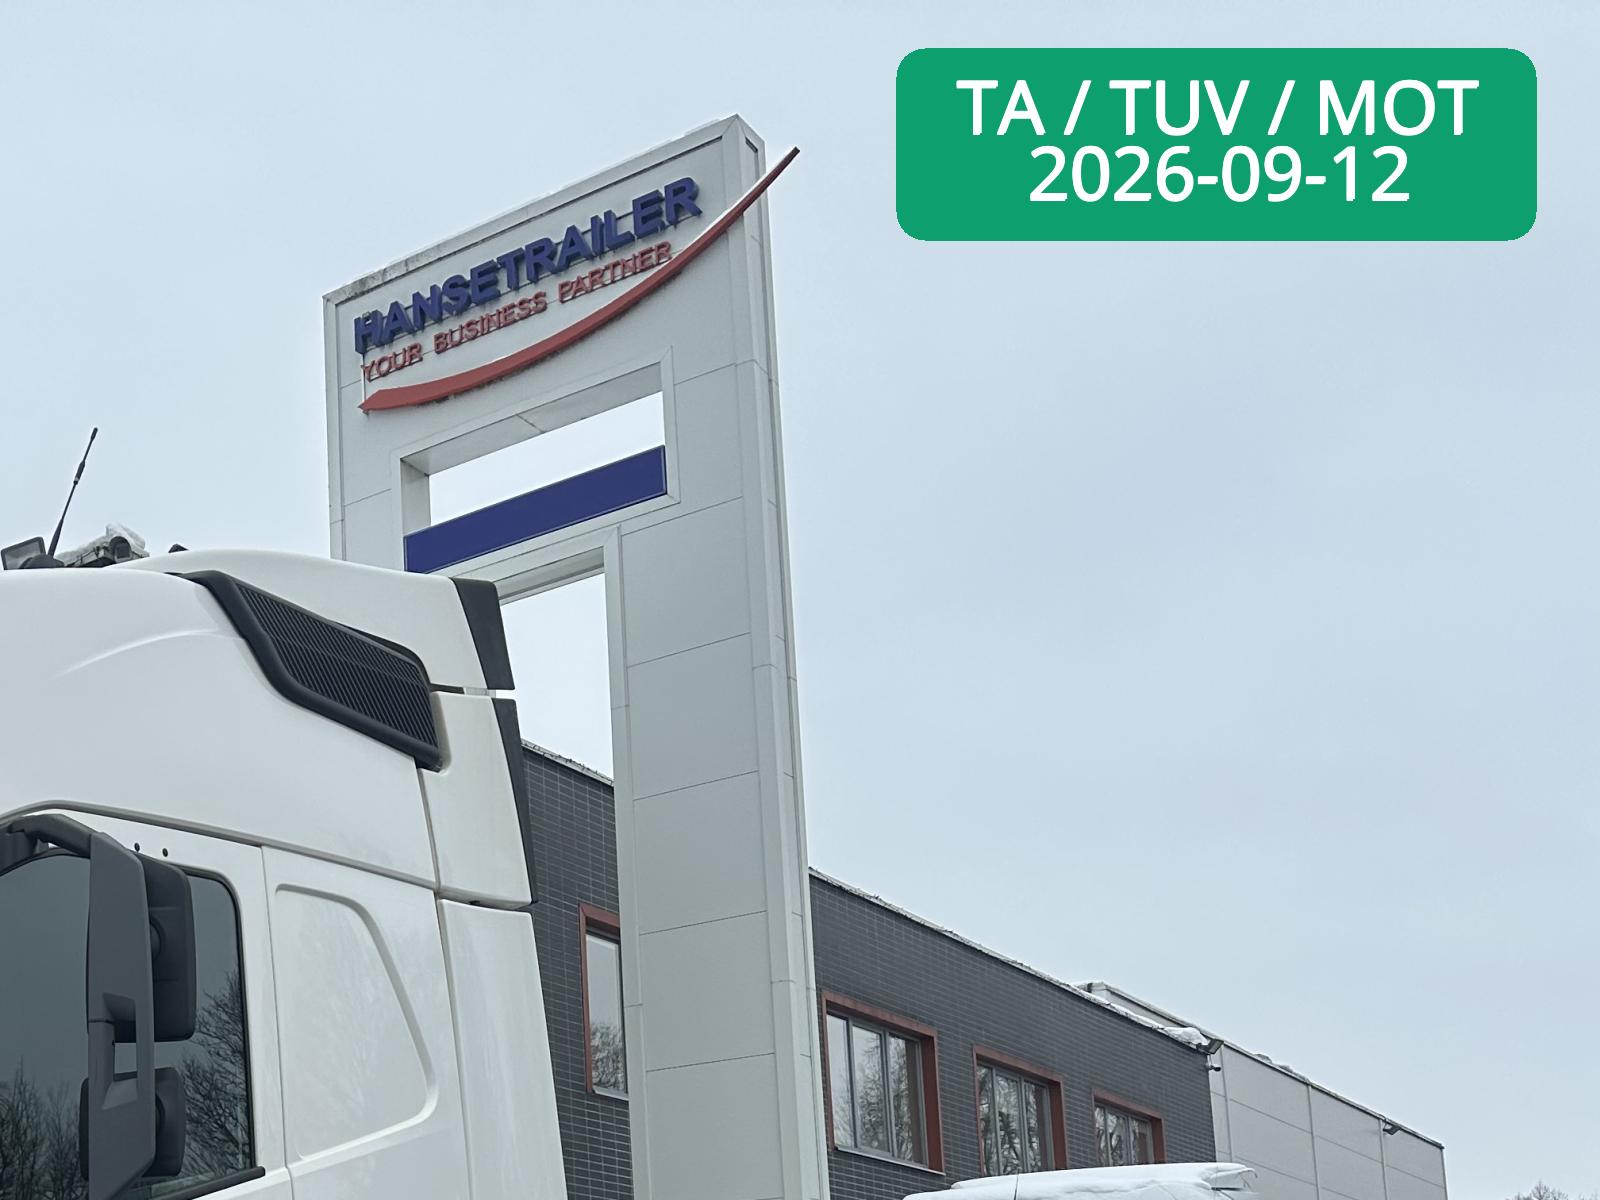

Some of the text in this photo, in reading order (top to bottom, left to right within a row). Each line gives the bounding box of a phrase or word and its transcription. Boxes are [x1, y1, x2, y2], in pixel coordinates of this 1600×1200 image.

[354, 176, 703, 354] HANSETRAILER
[362, 241, 673, 383] YOUR BUSINESS PARTNER
